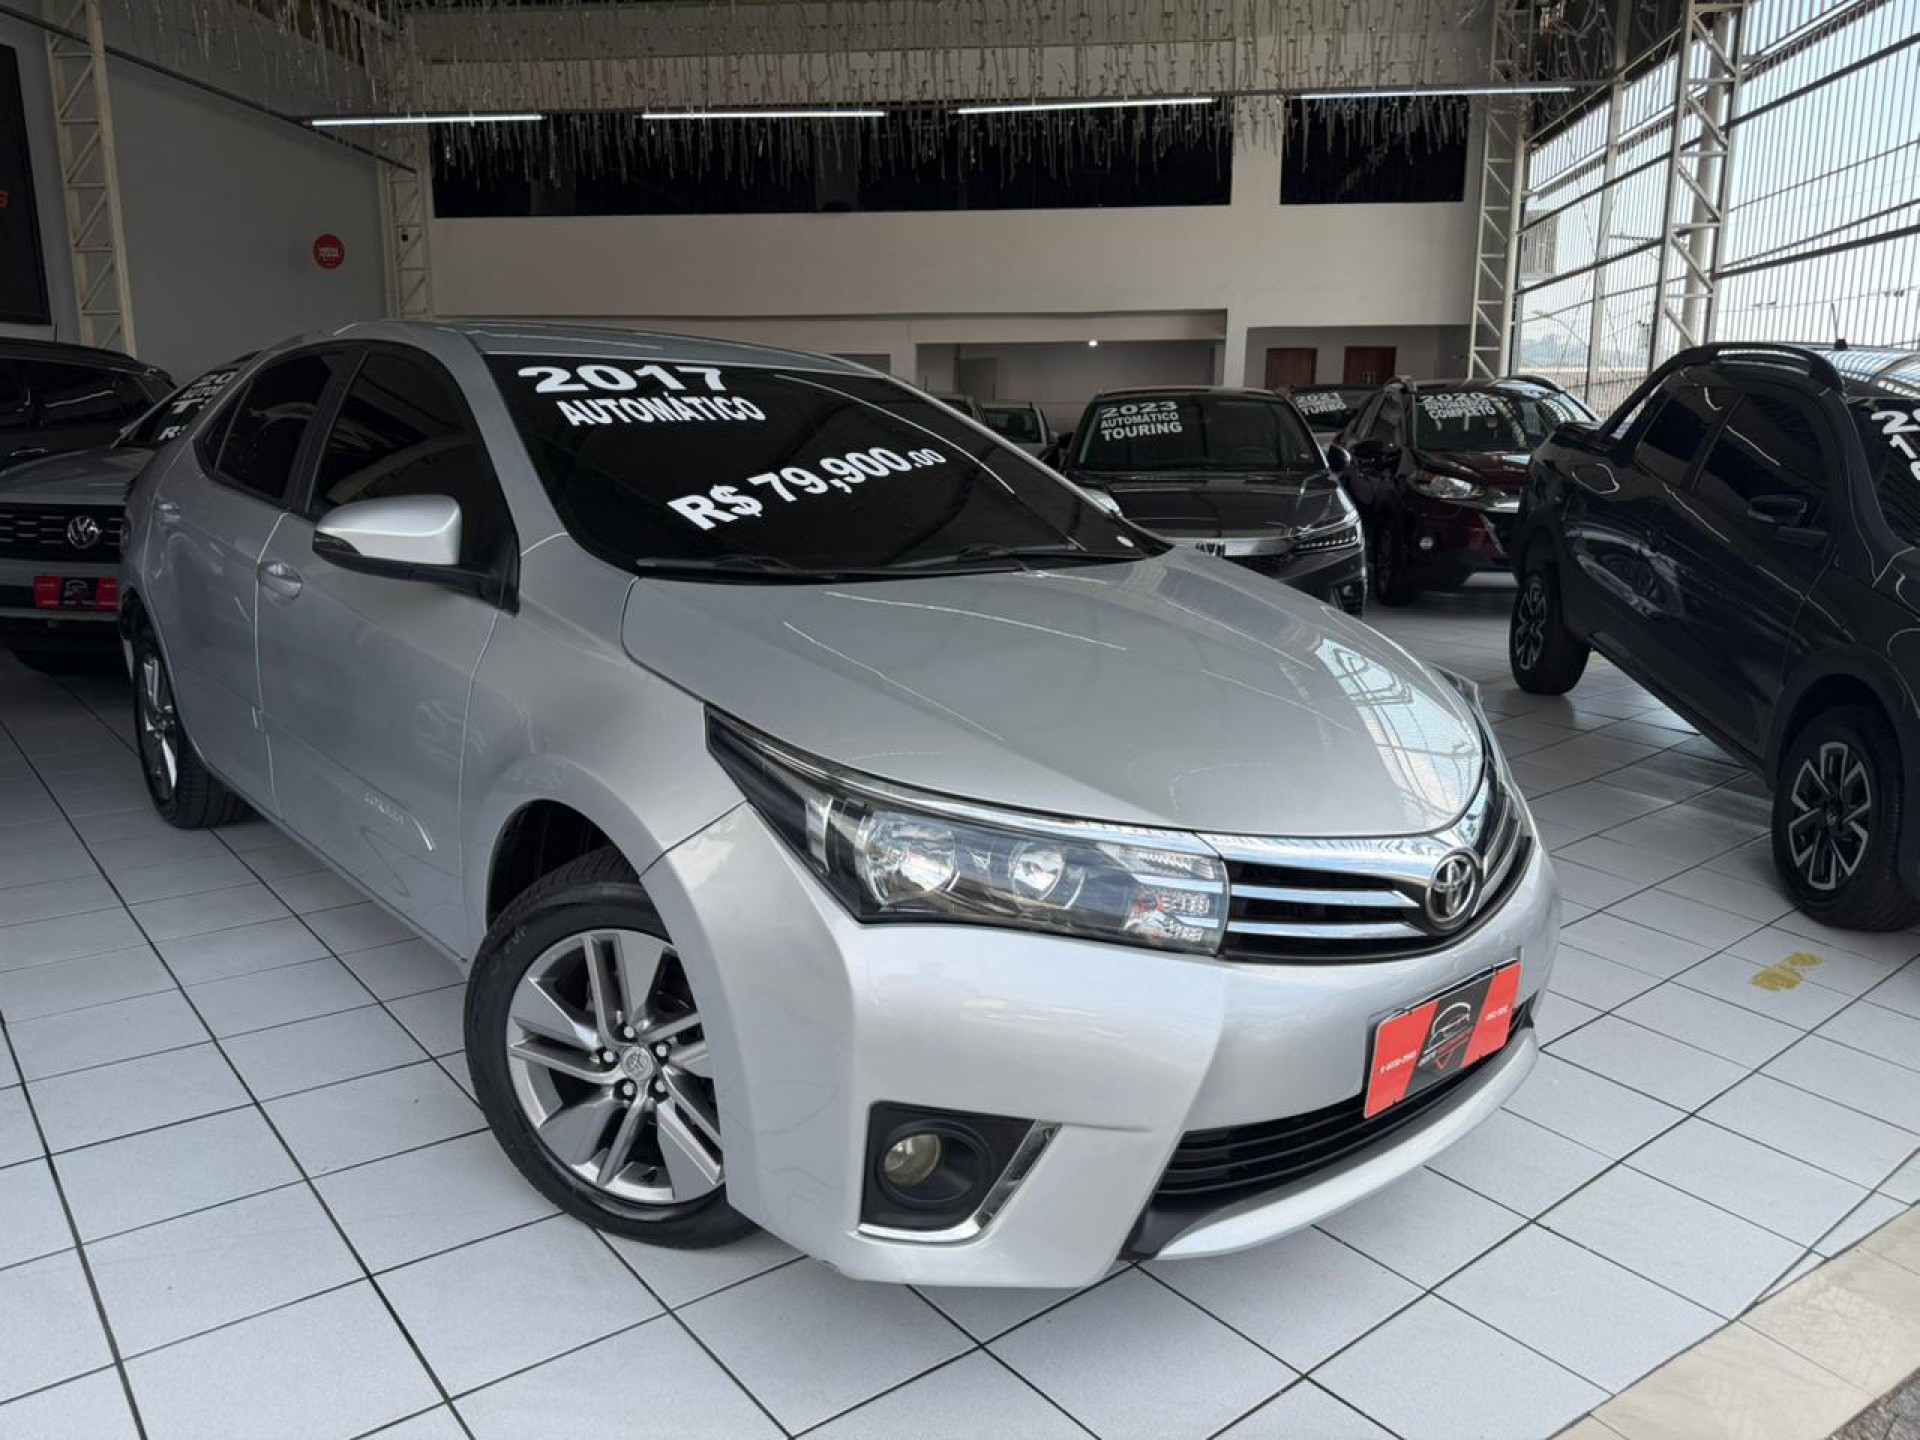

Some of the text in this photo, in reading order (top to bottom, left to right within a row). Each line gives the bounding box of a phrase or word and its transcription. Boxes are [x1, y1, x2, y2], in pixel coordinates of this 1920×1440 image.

[518, 364, 728, 394] 2017
[556, 391, 767, 427] AUTOMÁTICO
[1102, 401, 1178, 419] 2023
[1101, 421, 1183, 441] TOURING
[666, 484, 764, 531] R$
